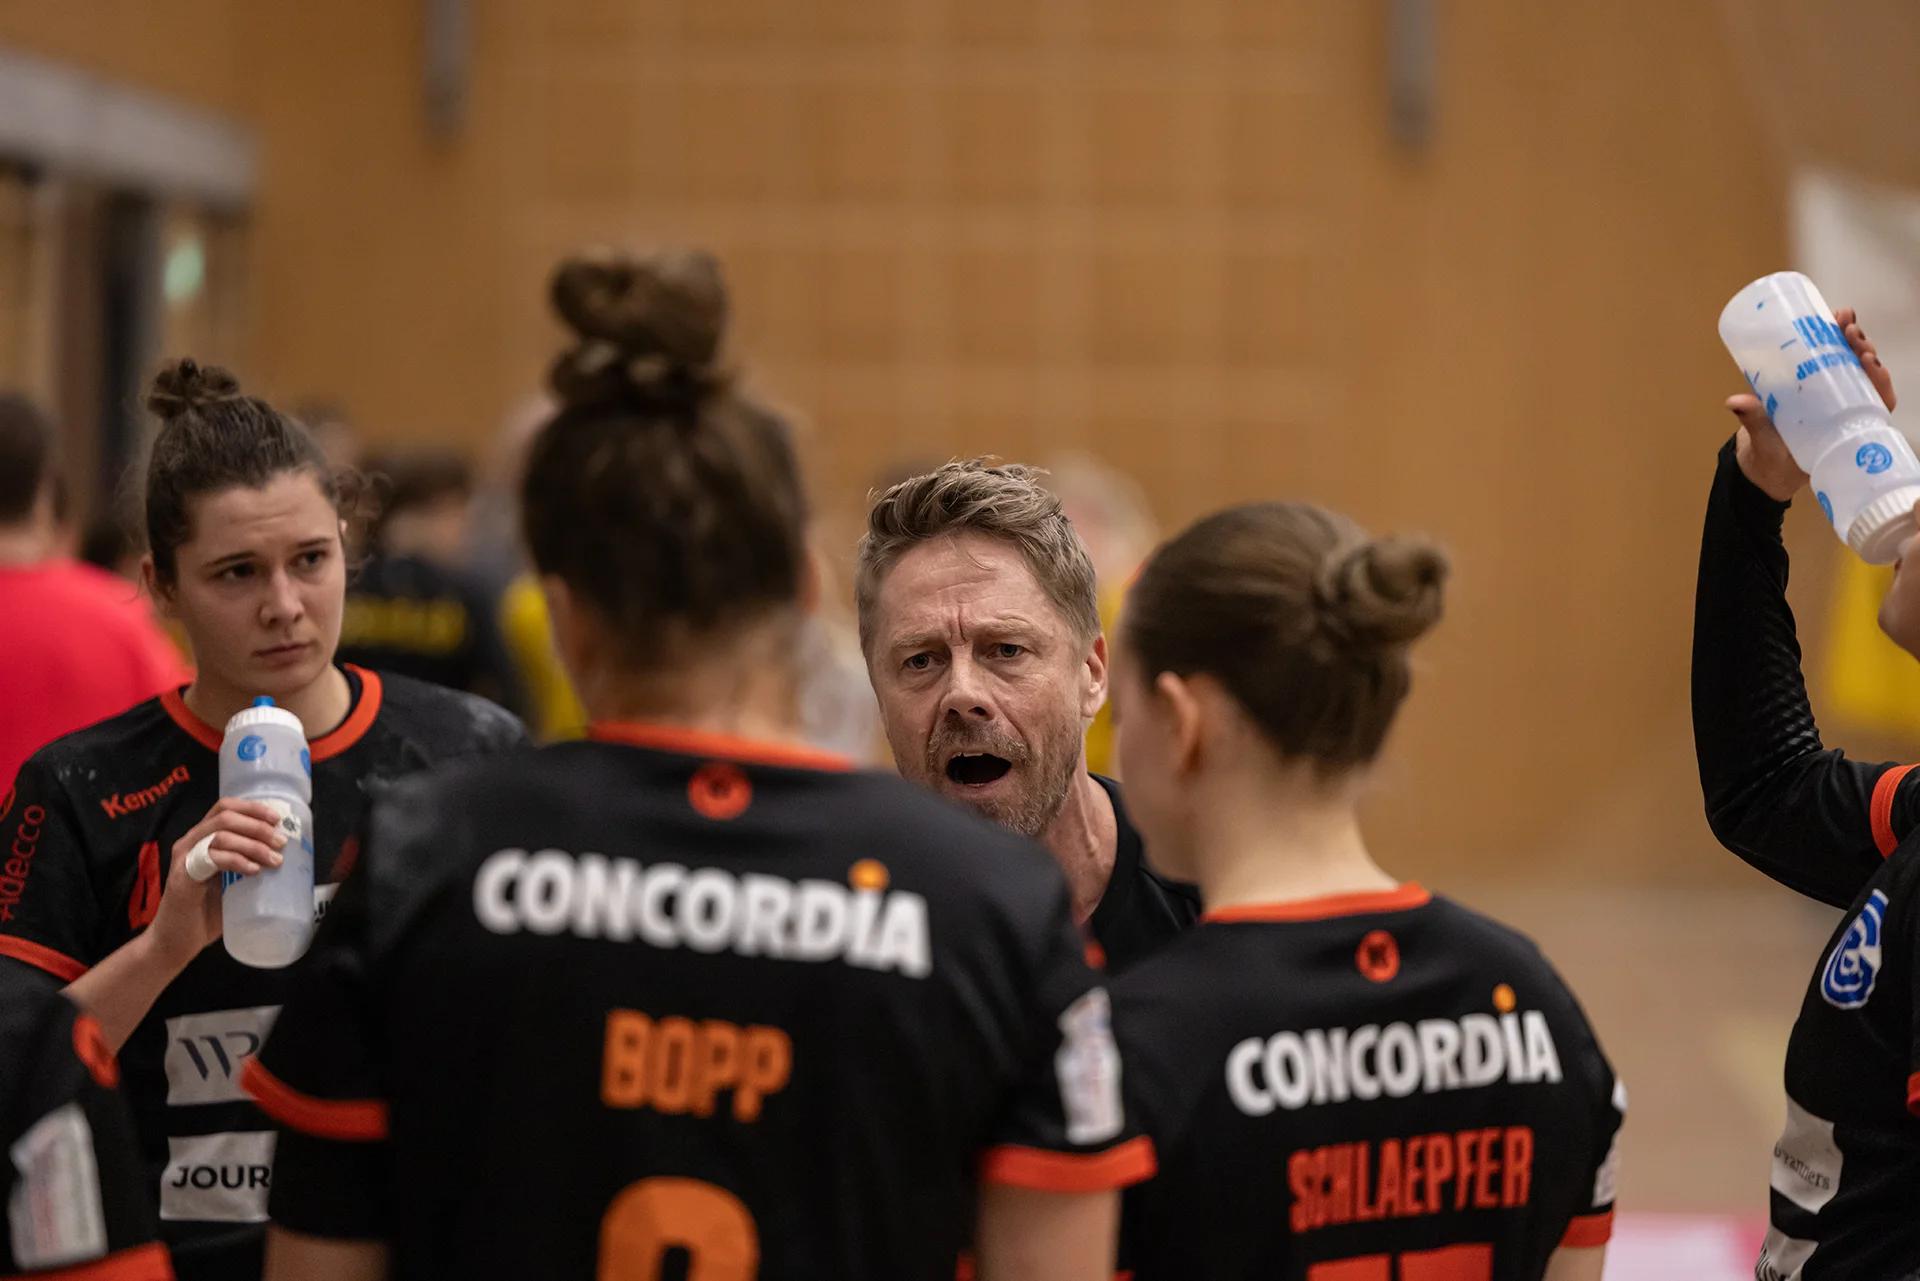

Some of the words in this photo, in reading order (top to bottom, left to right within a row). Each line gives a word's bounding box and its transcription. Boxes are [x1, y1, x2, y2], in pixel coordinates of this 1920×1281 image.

[473, 847, 933, 979] CONCORDIA
[602, 1008, 793, 1122] BOPP
[1225, 983, 1563, 1117] CONCORDIA
[1286, 1126, 1535, 1233] SCHLAEPFER
